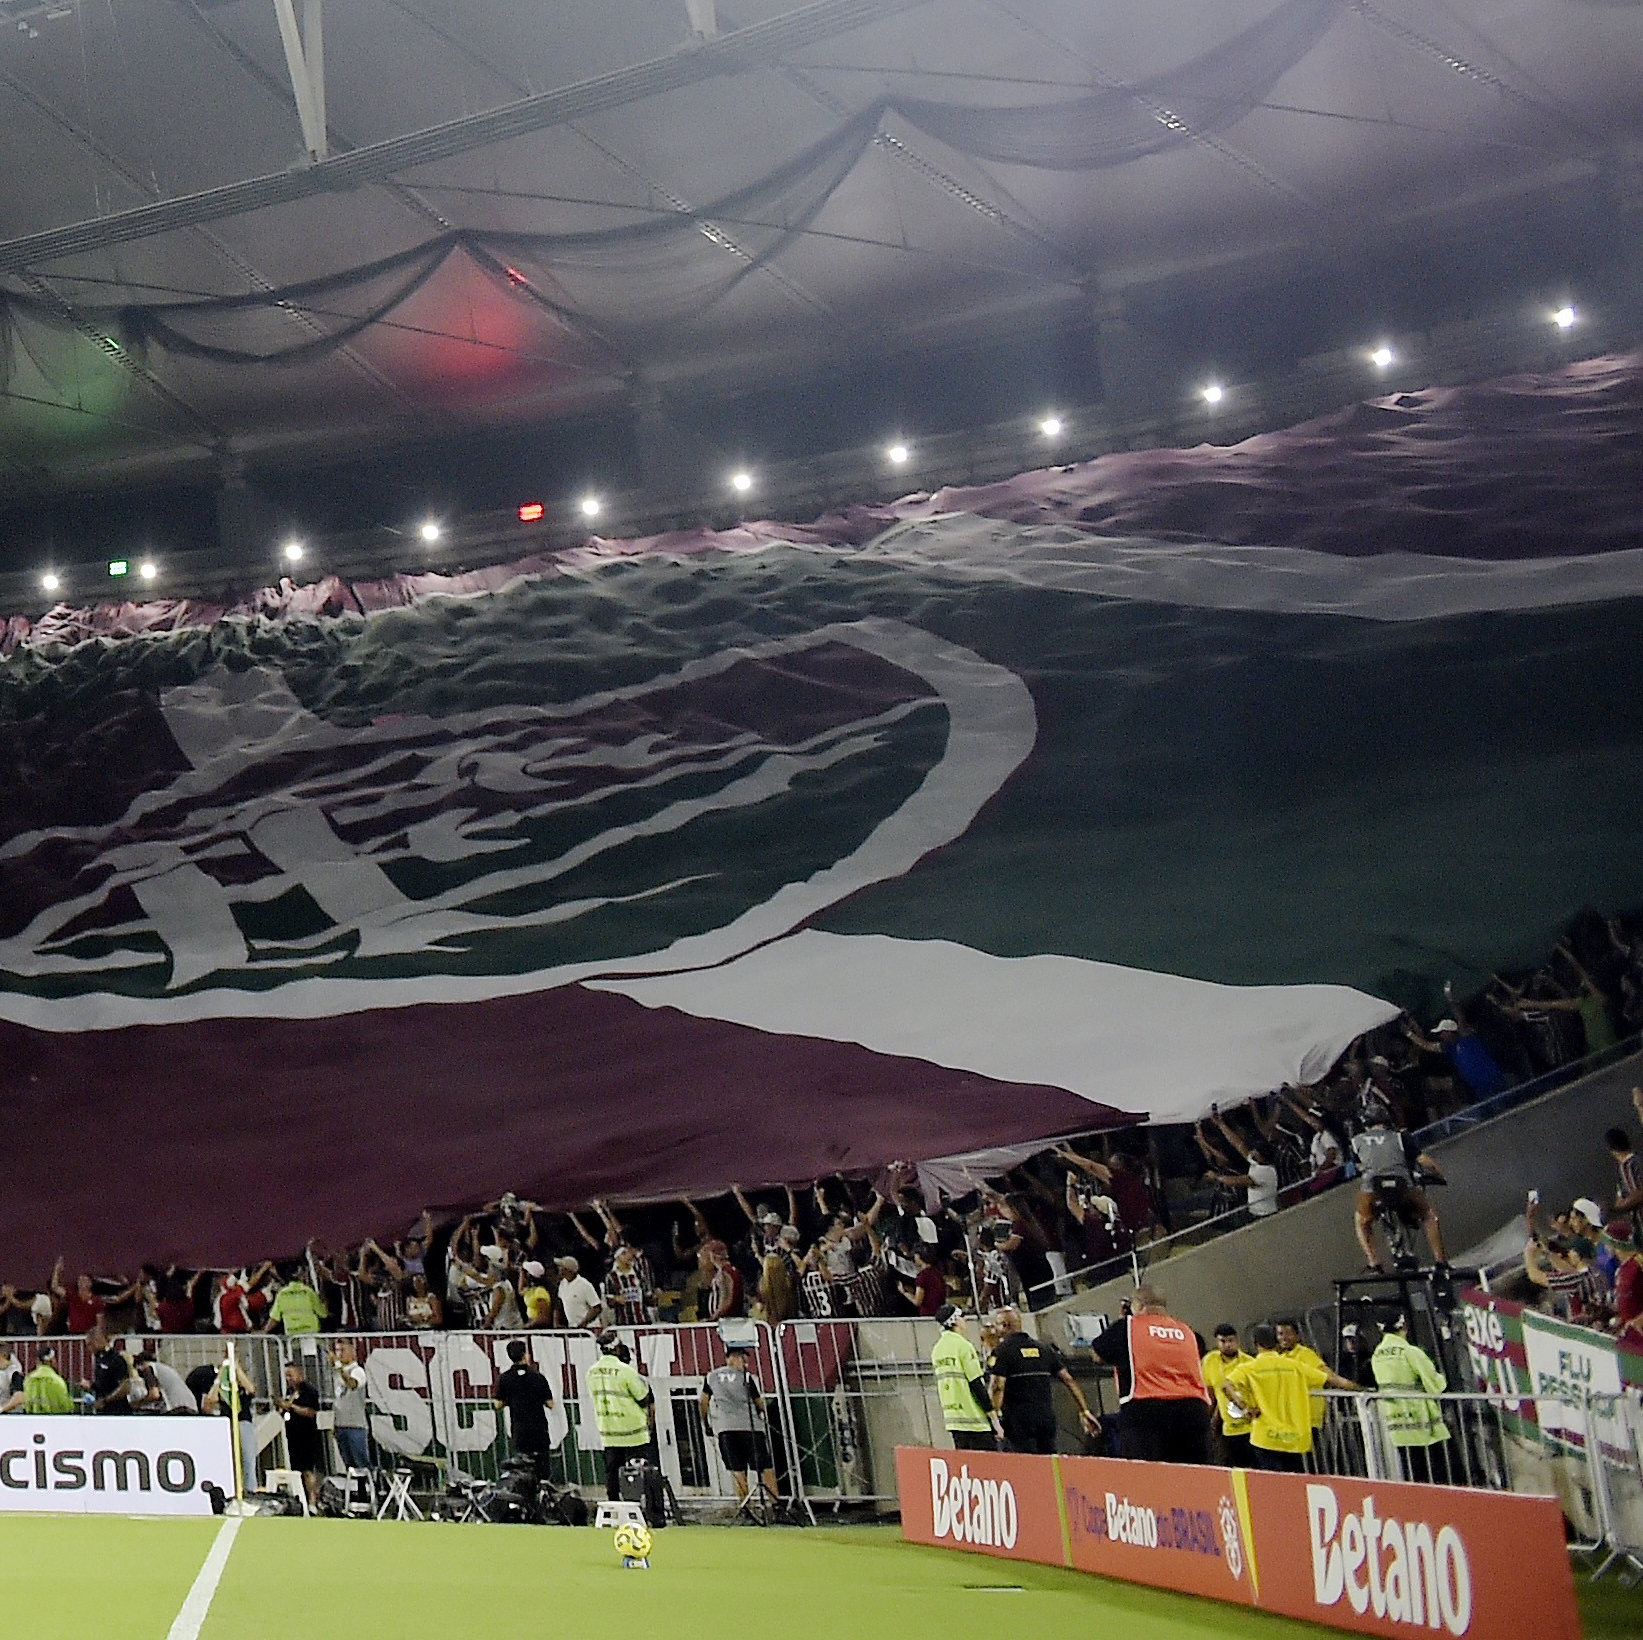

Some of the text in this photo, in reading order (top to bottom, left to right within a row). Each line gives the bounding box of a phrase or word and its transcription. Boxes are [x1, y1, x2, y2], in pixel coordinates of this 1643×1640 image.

[1363, 1136, 1385, 1145] TV
[1148, 1325, 1186, 1342] FOTO
[717, 1373, 737, 1383] TV
[929, 1457, 1018, 1550] Betano
[1105, 1492, 1157, 1548] Betano
[1306, 1483, 1472, 1637] Betano
